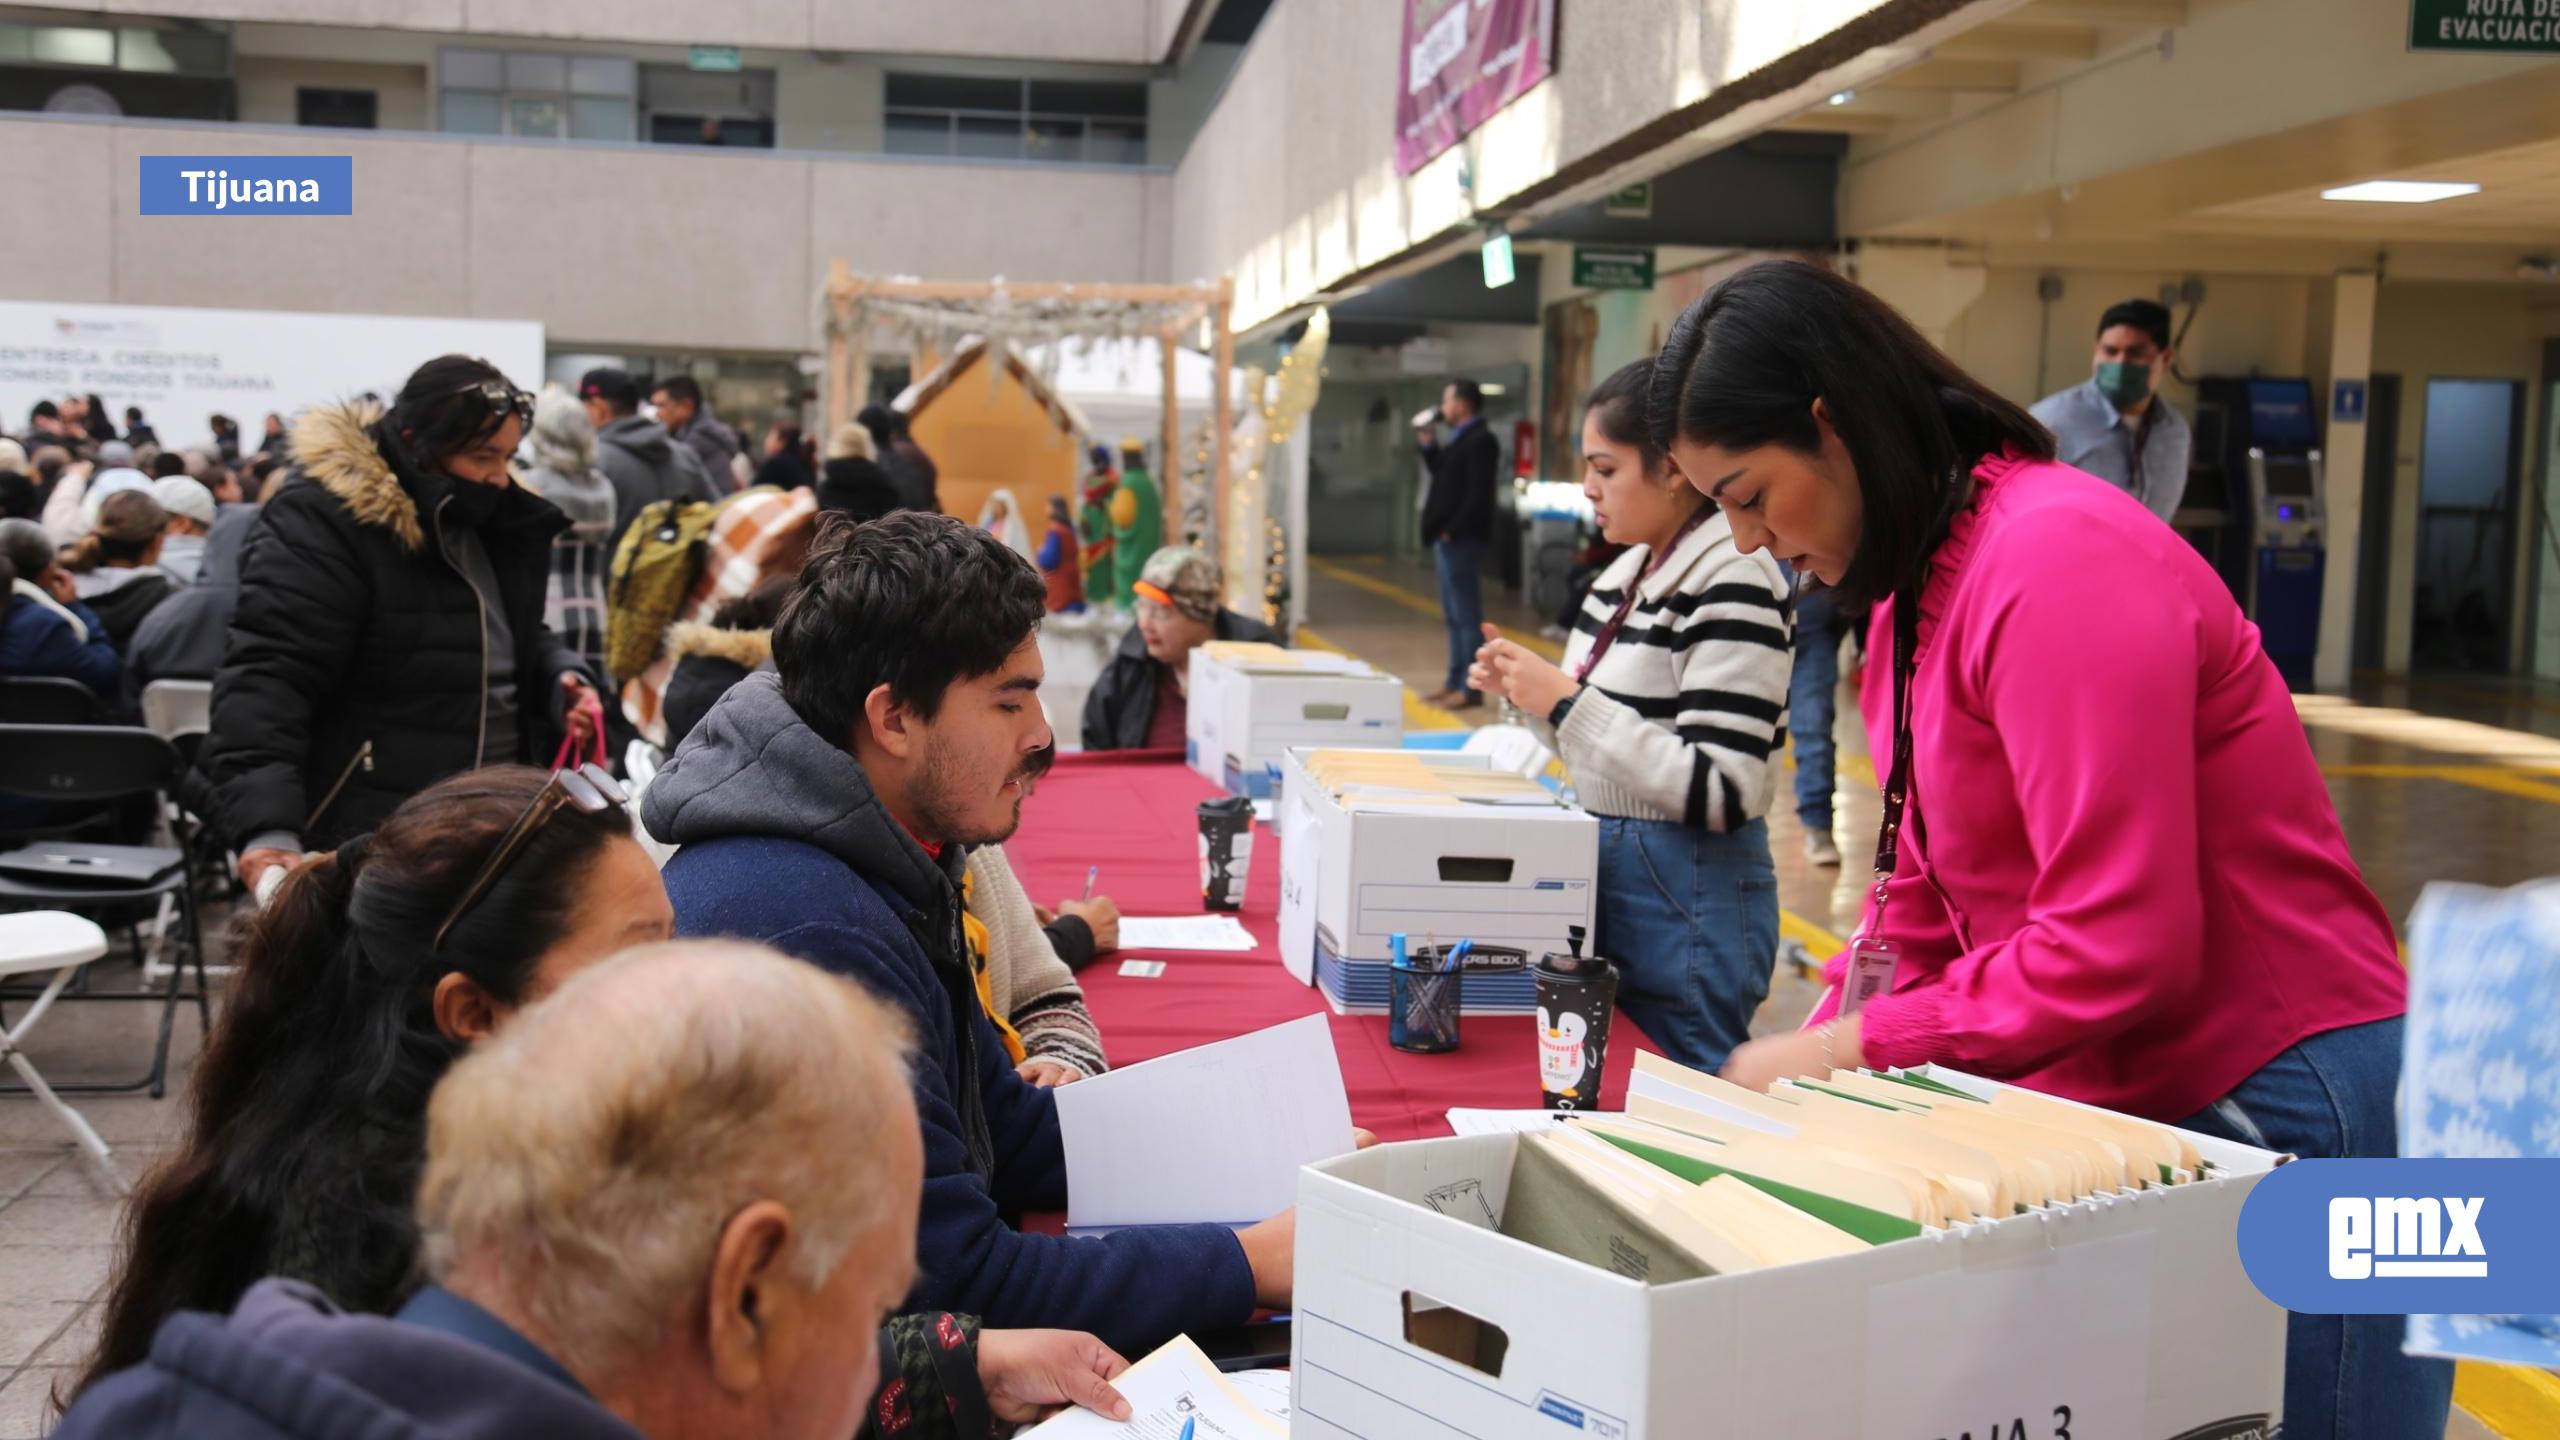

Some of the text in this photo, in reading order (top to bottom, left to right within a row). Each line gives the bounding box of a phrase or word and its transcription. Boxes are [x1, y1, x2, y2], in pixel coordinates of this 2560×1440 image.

[2466, 0, 2525, 16] RUTA
[1491, 955, 1520, 965] BOX
[2053, 1404, 2071, 1440] 3
